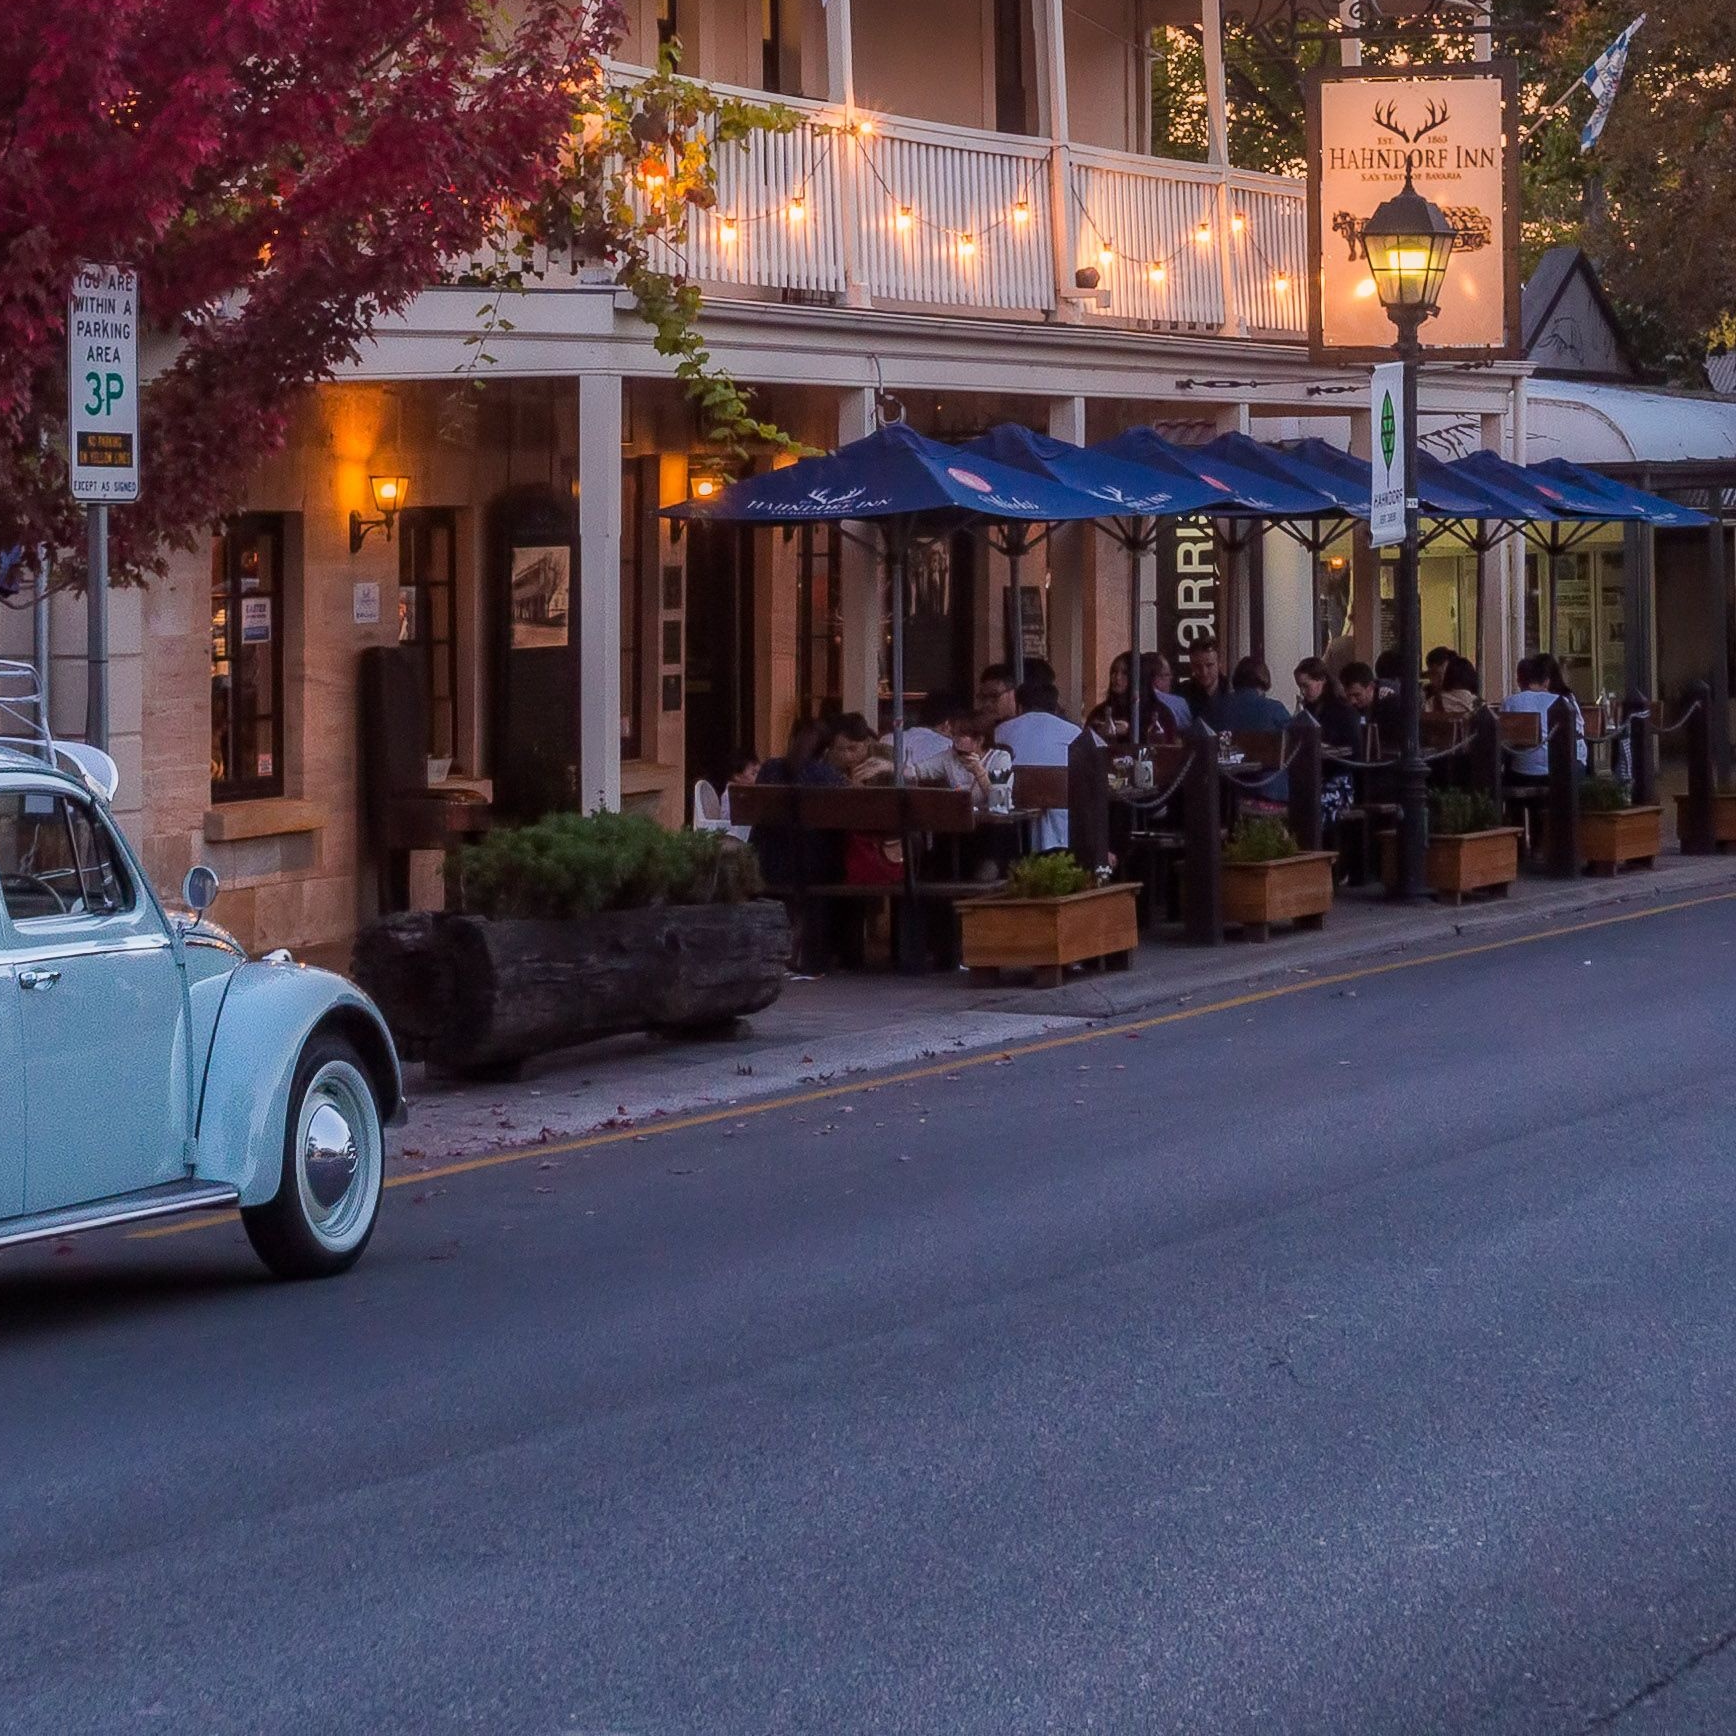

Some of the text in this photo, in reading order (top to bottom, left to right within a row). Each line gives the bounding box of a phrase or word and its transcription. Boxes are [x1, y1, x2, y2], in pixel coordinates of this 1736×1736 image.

[1427, 135, 1448, 145] 1863
[1329, 145, 1496, 170] HAHNDORF INN
[108, 274, 132, 292] ARE
[73, 296, 132, 316] WITHIN A
[76, 319, 131, 340] PARKING
[86, 345, 121, 364] AREA
[84, 371, 124, 416] 3P
[73, 480, 137, 493] EXCEPT AS SIGNED
